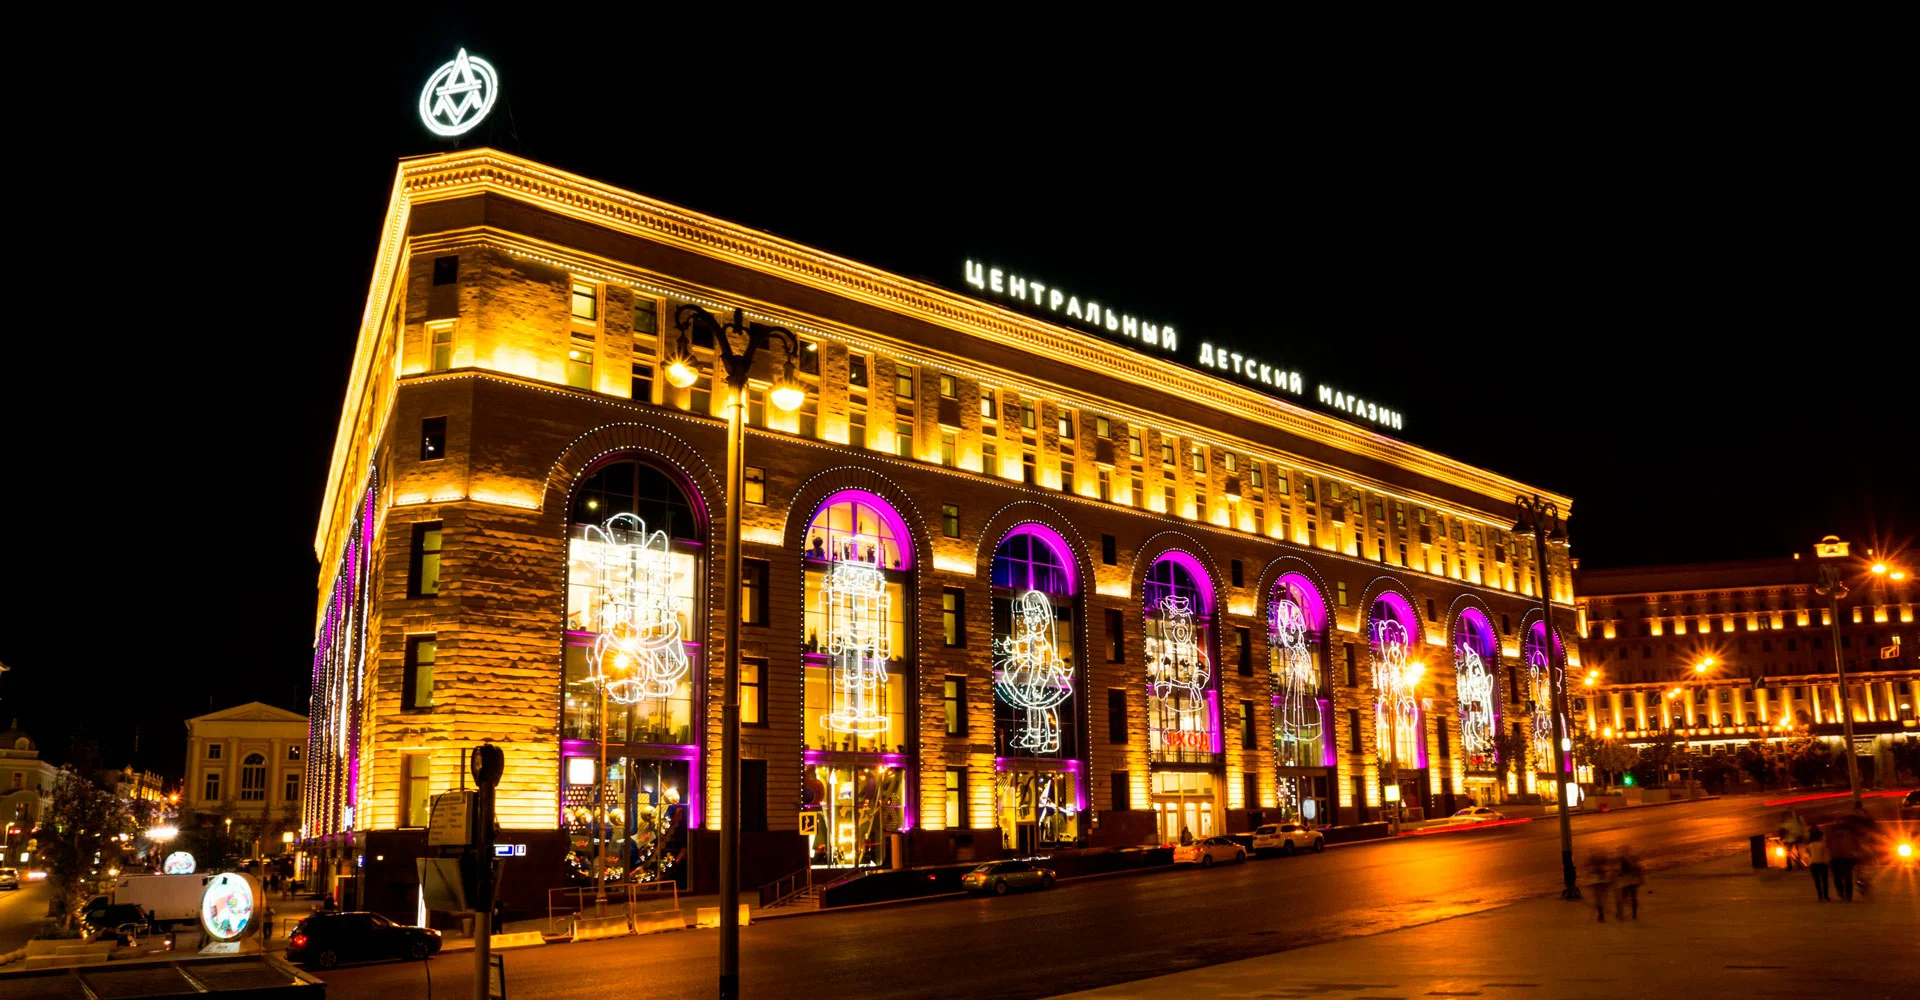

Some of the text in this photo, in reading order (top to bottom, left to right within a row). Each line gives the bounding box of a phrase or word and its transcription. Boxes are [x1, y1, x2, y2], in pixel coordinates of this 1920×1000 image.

[965, 259, 1403, 431] ЦЕНТРАЛЬНЫЙ ДЕТСКИЙ МАГАЗИН
[1167, 731, 1210, 751] ВХОД
